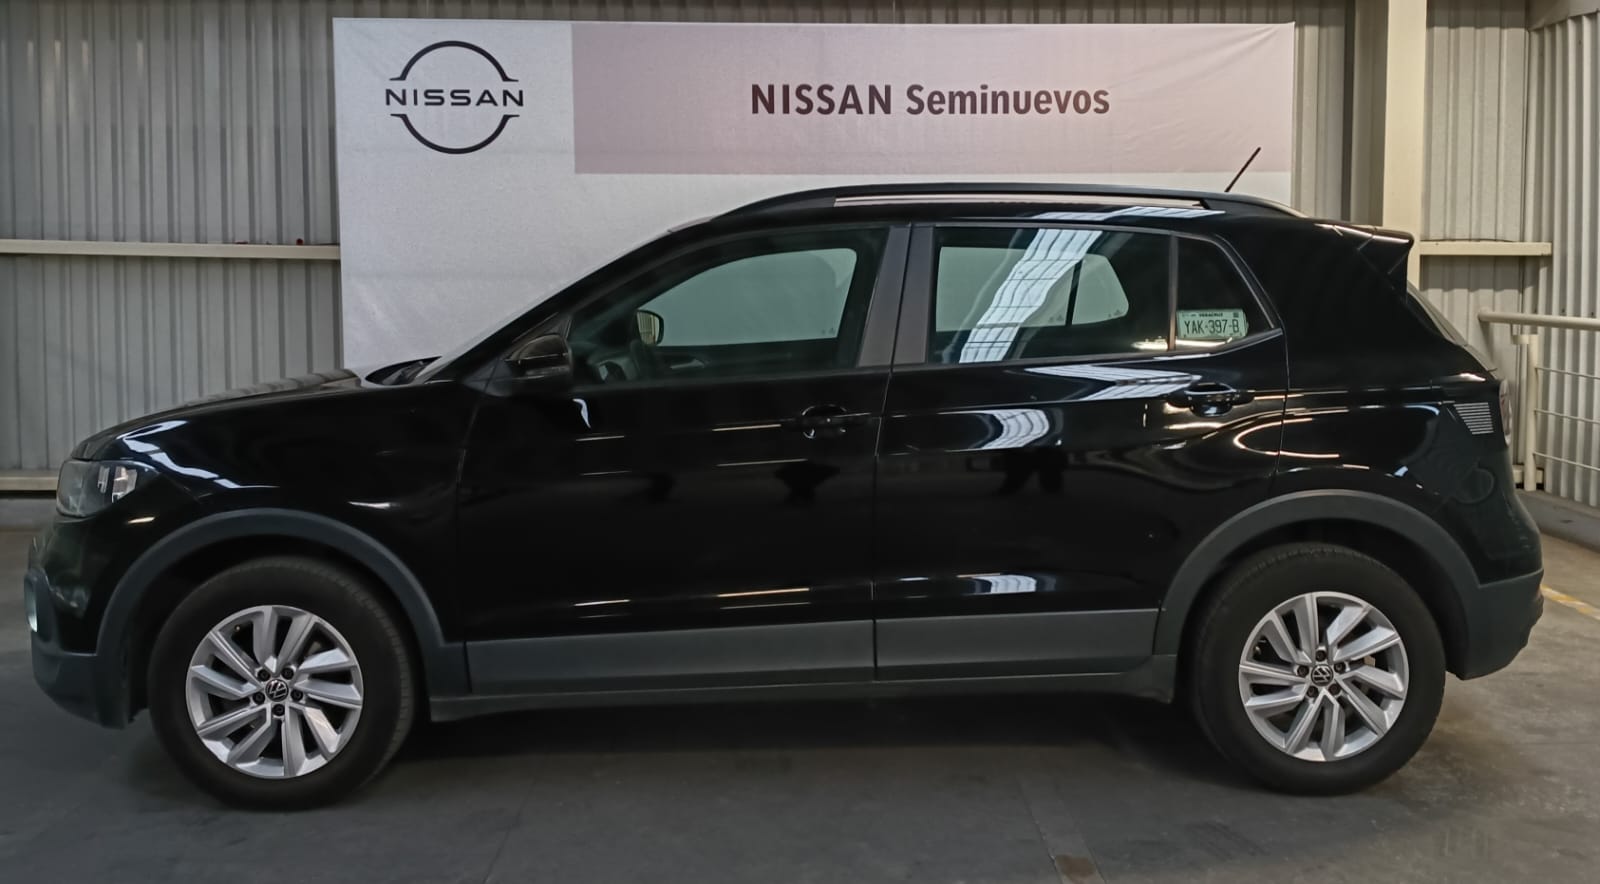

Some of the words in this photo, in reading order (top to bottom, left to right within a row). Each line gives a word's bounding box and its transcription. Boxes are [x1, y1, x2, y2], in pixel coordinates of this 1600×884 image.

[385, 88, 524, 107] NISSAN
[751, 83, 892, 115] NISSAN
[905, 83, 1111, 115] Seminuevos
[1184, 318, 1240, 335] YAK-397-B
